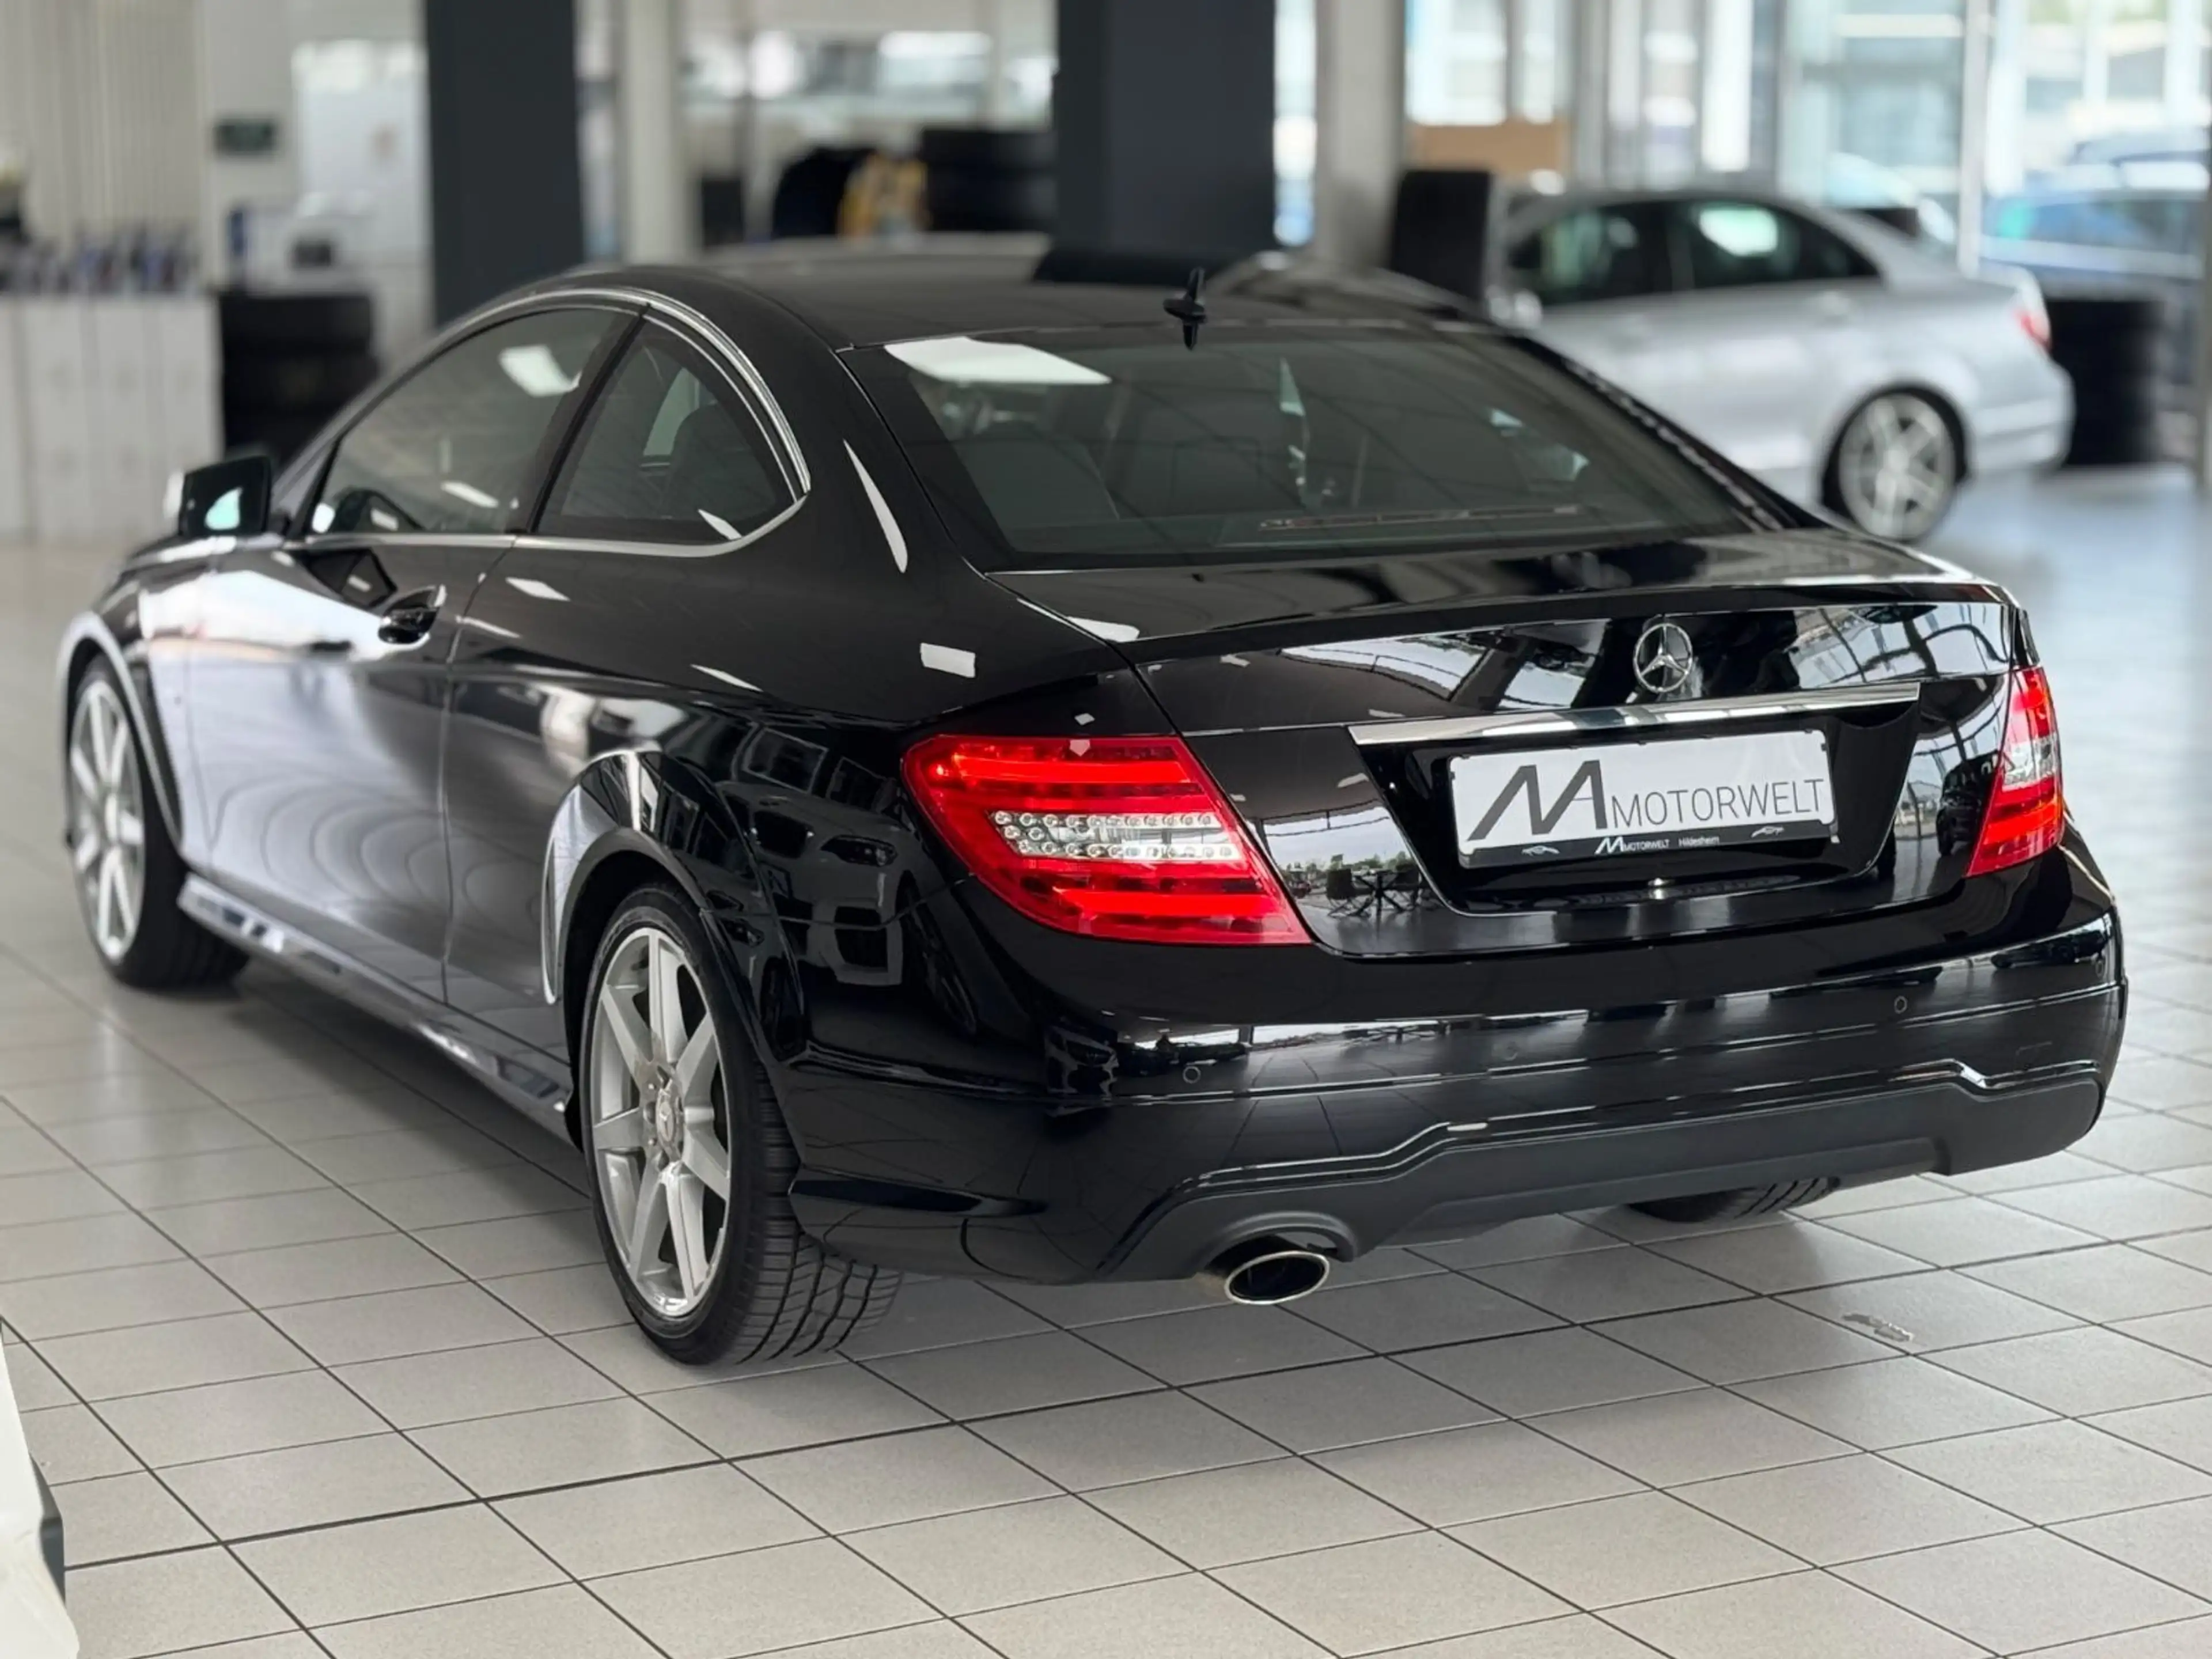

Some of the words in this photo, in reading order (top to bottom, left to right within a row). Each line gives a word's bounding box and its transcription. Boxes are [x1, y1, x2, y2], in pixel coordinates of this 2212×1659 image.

[1612, 779, 1824, 828] MOTORWELT
[1623, 838, 1669, 852] MOTORWELT
[1678, 836, 1719, 847] Hildesheim
